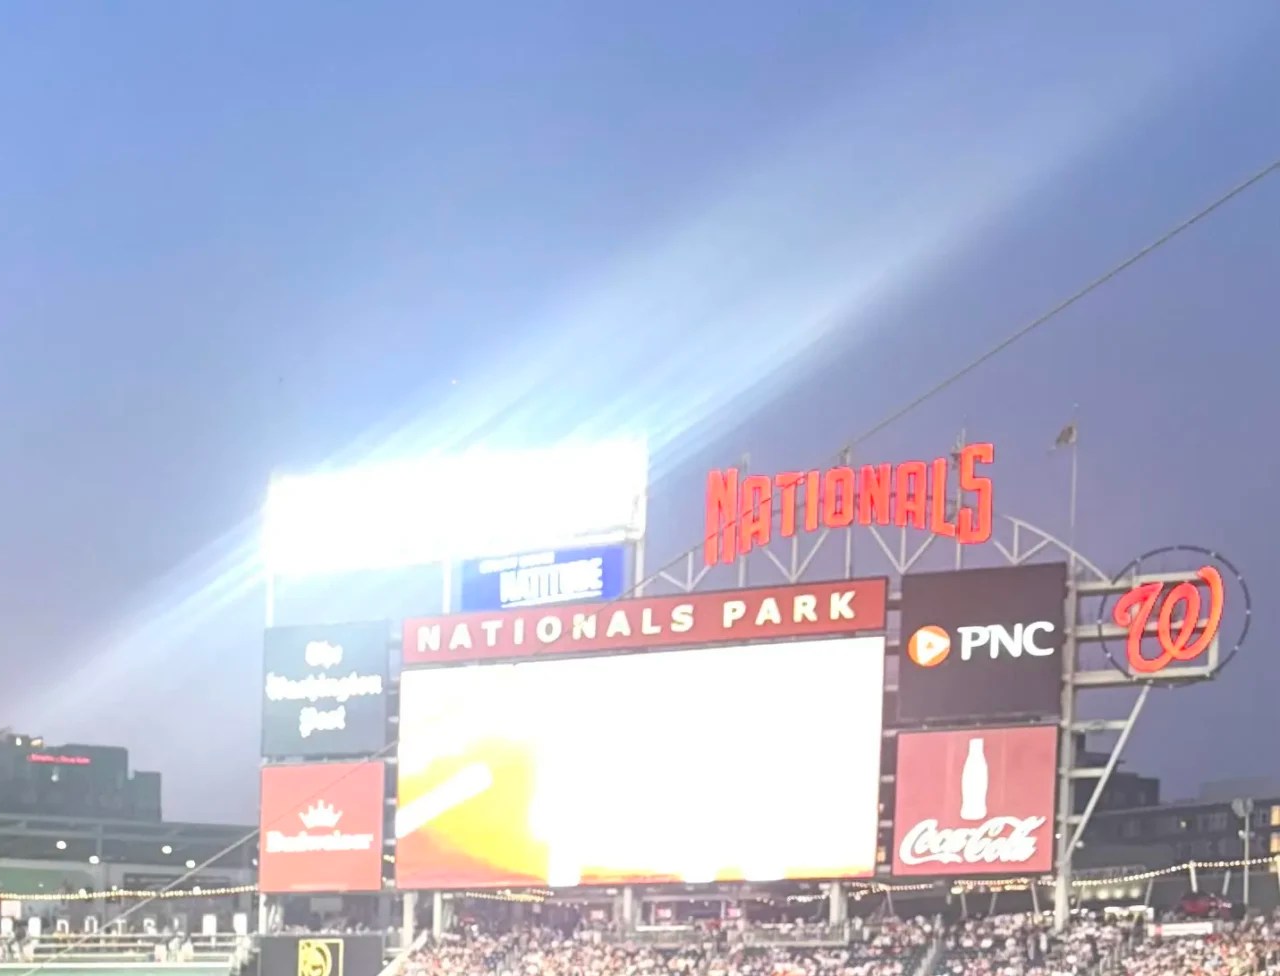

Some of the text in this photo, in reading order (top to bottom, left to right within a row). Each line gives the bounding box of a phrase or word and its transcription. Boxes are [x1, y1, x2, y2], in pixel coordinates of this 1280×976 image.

[704, 442, 995, 566] NATIONALS
[417, 591, 856, 652] NATIONALS PARK
[956, 621, 1055, 661] PNC
[1113, 565, 1224, 673] W
